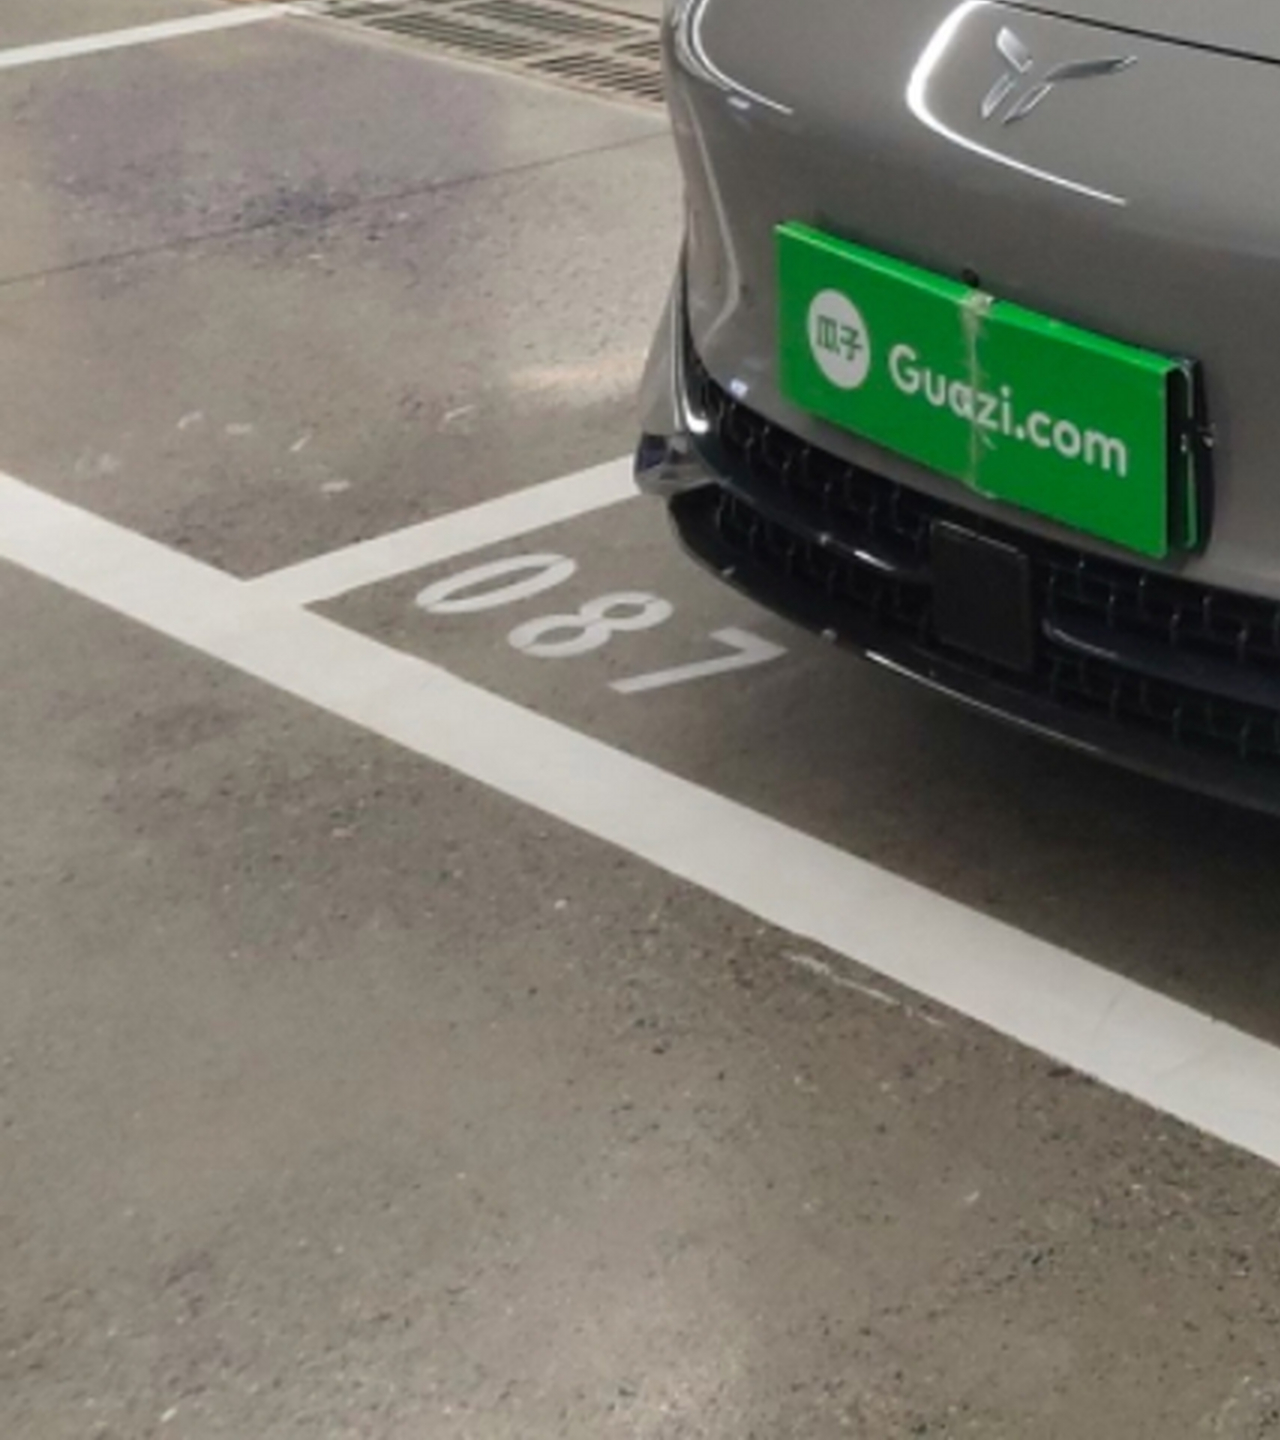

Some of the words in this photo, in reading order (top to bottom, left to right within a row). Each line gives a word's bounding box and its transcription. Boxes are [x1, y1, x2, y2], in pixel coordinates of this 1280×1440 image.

[816, 313, 863, 362] 瓜子
[888, 343, 1127, 478] Guazi.com
[414, 553, 788, 695] 087
